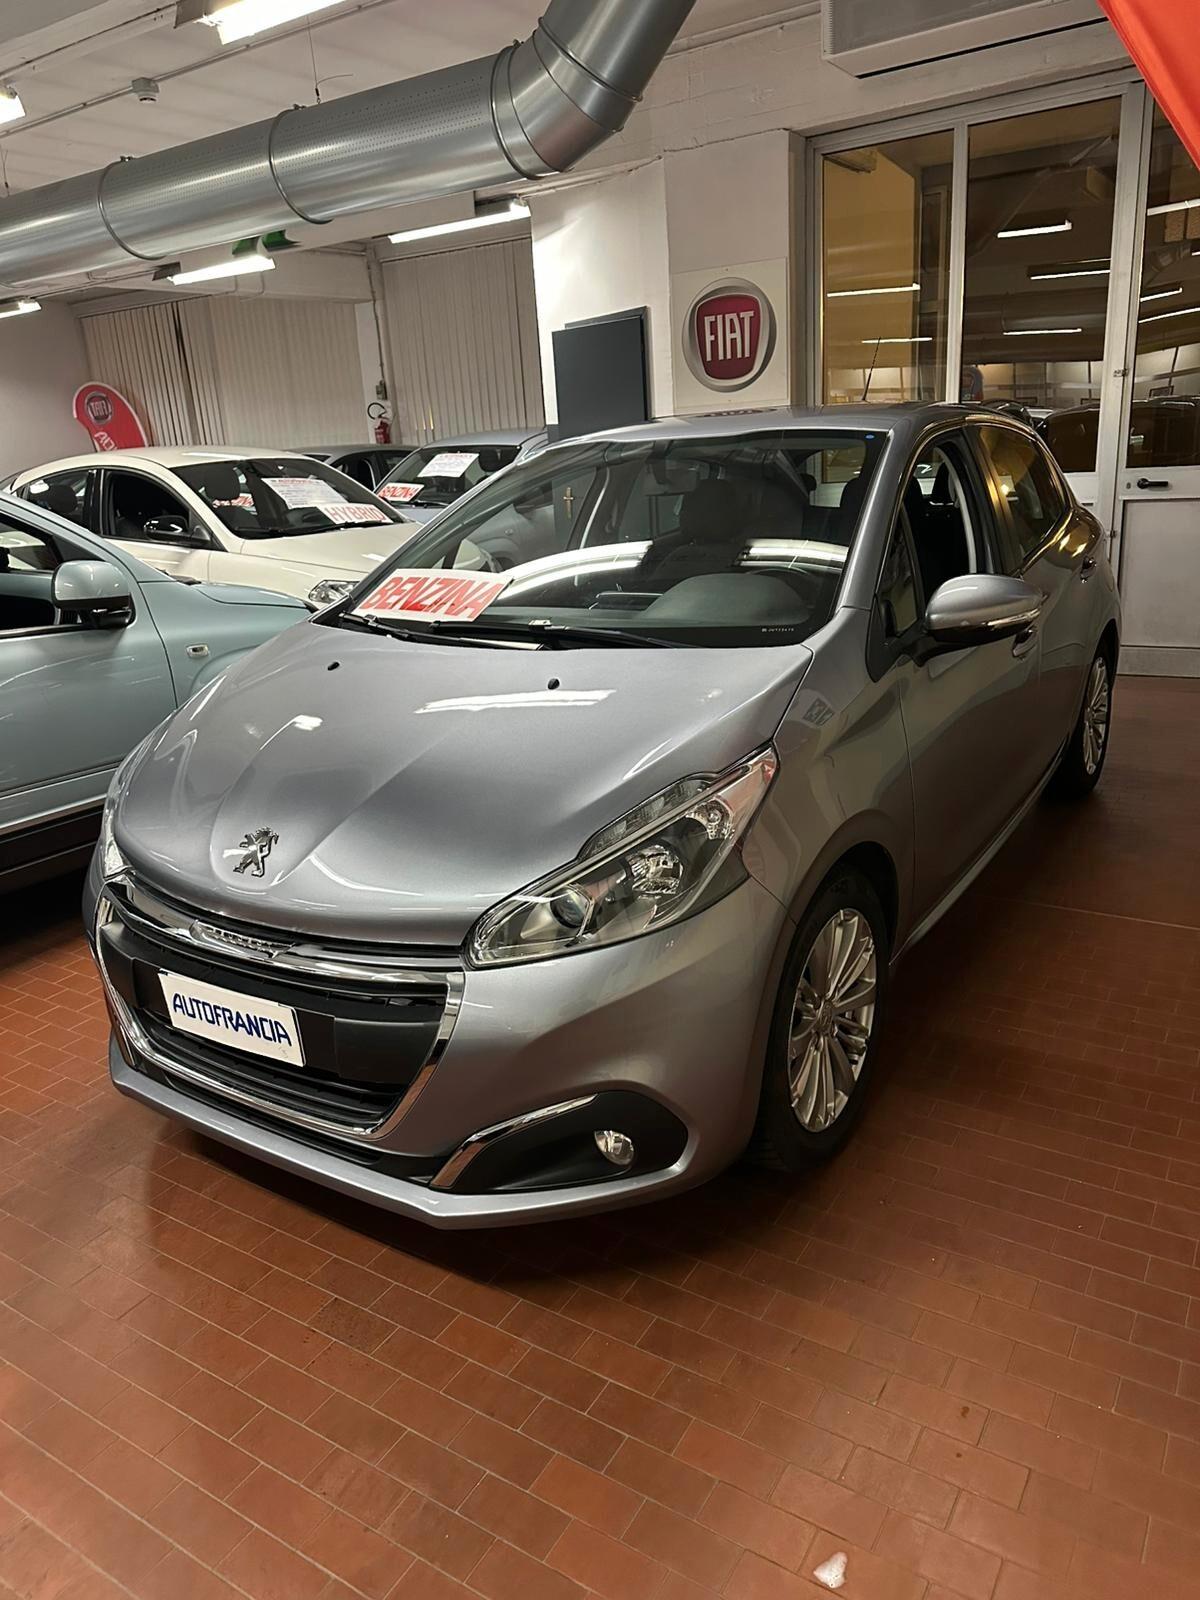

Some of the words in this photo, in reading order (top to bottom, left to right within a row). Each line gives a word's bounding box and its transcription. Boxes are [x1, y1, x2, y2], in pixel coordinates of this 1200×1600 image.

[704, 310, 755, 362] FIAT
[378, 485, 419, 499] BENZINA
[324, 506, 387, 522] HYBRID
[359, 576, 505, 619] BENZINA
[172, 992, 293, 1047] AUTOFRANCIA
